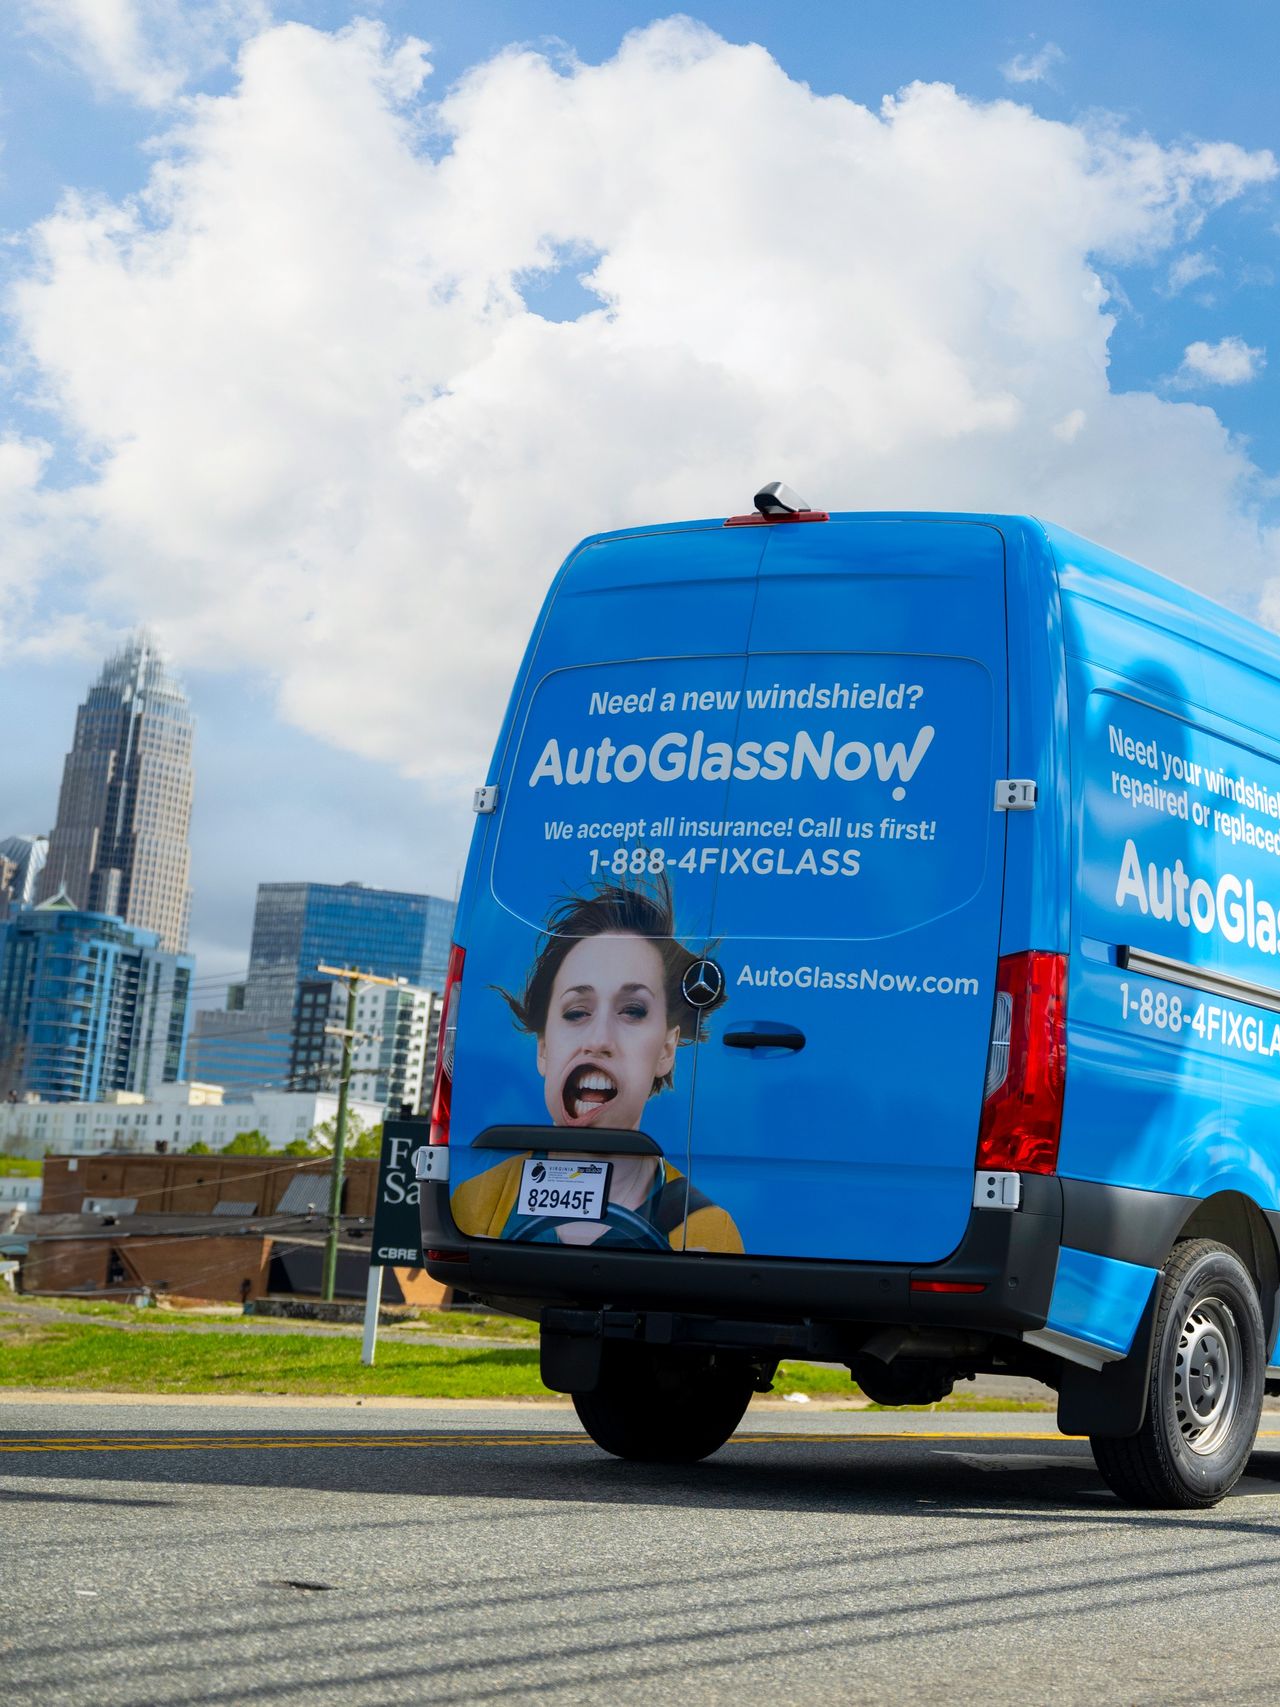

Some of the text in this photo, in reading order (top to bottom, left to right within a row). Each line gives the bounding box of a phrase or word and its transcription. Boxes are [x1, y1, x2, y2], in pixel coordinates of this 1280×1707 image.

[589, 683, 924, 715] Need a new windshield?
[529, 725, 935, 801] AutoGlassNow!
[1108, 724, 1158, 770] Need
[1161, 751, 1202, 787] your
[1112, 770, 1189, 821] repaired
[1192, 801, 1210, 828] or
[543, 816, 937, 841] We accept all insurance! Call us first!
[588, 847, 861, 877] 1-888-4FIXGLASS
[736, 964, 979, 996] AutoGlassNow.com
[528, 1188, 595, 1210] 82945F
[377, 1247, 418, 1261] CBRE
